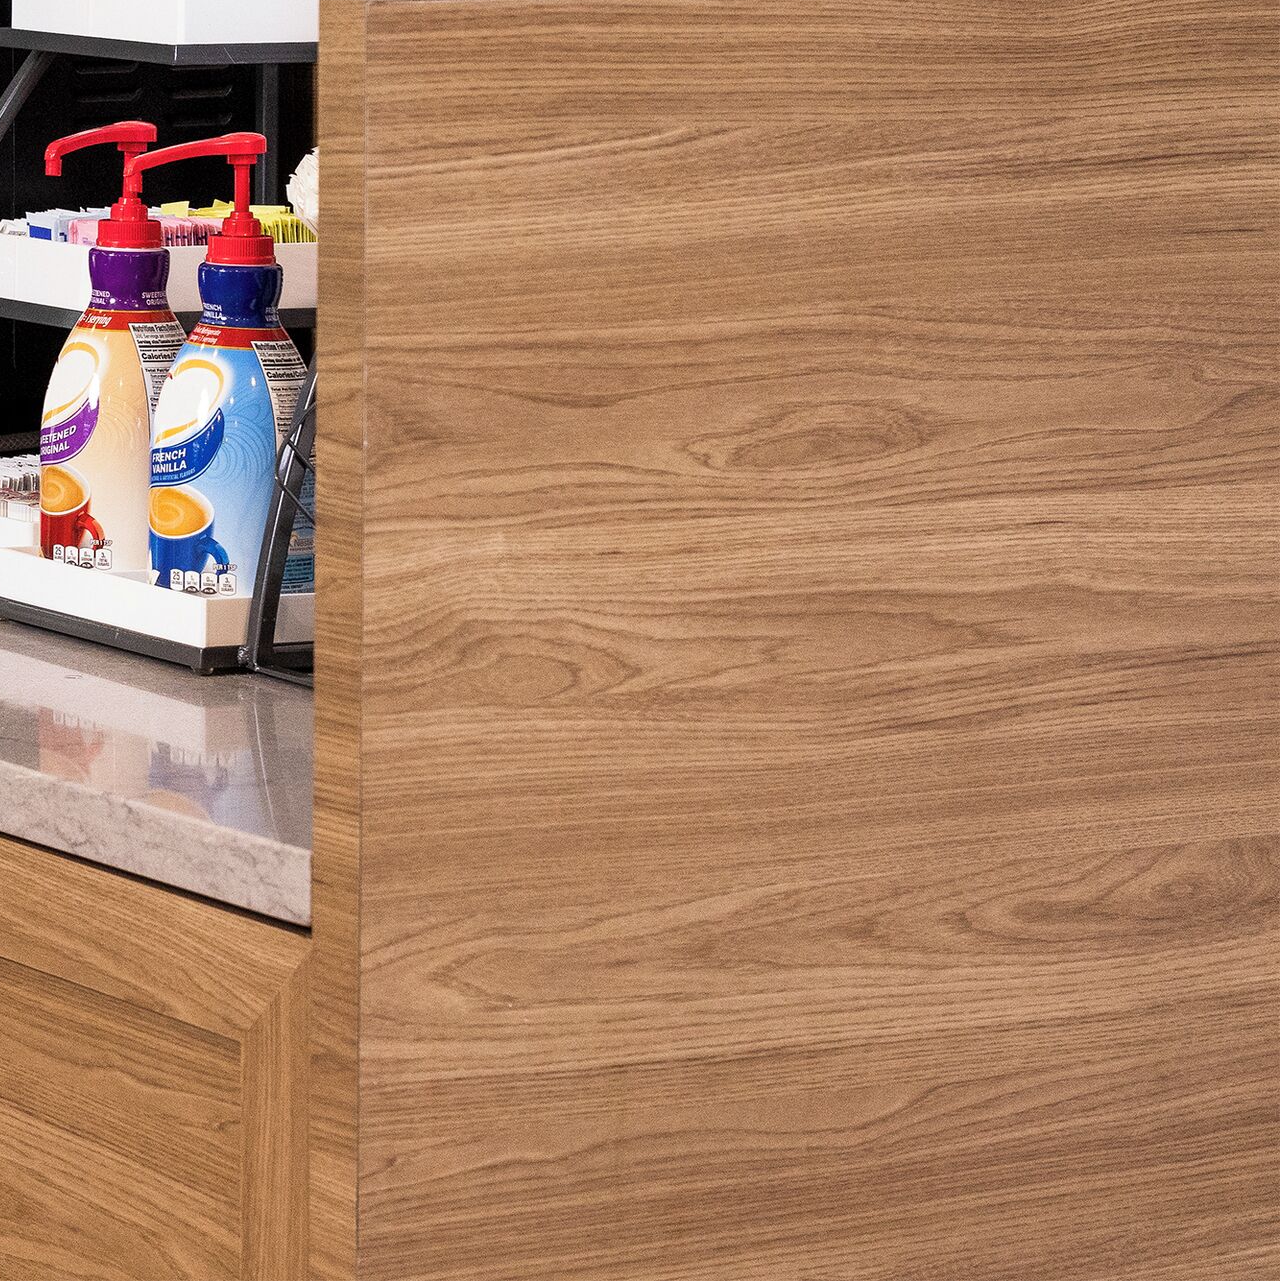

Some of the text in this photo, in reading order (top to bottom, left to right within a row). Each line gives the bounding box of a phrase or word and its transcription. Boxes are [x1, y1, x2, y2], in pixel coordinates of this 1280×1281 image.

[152, 448, 187, 463] FRENCH
[152, 460, 187, 474] VANILLA
[172, 570, 180, 580] 25
